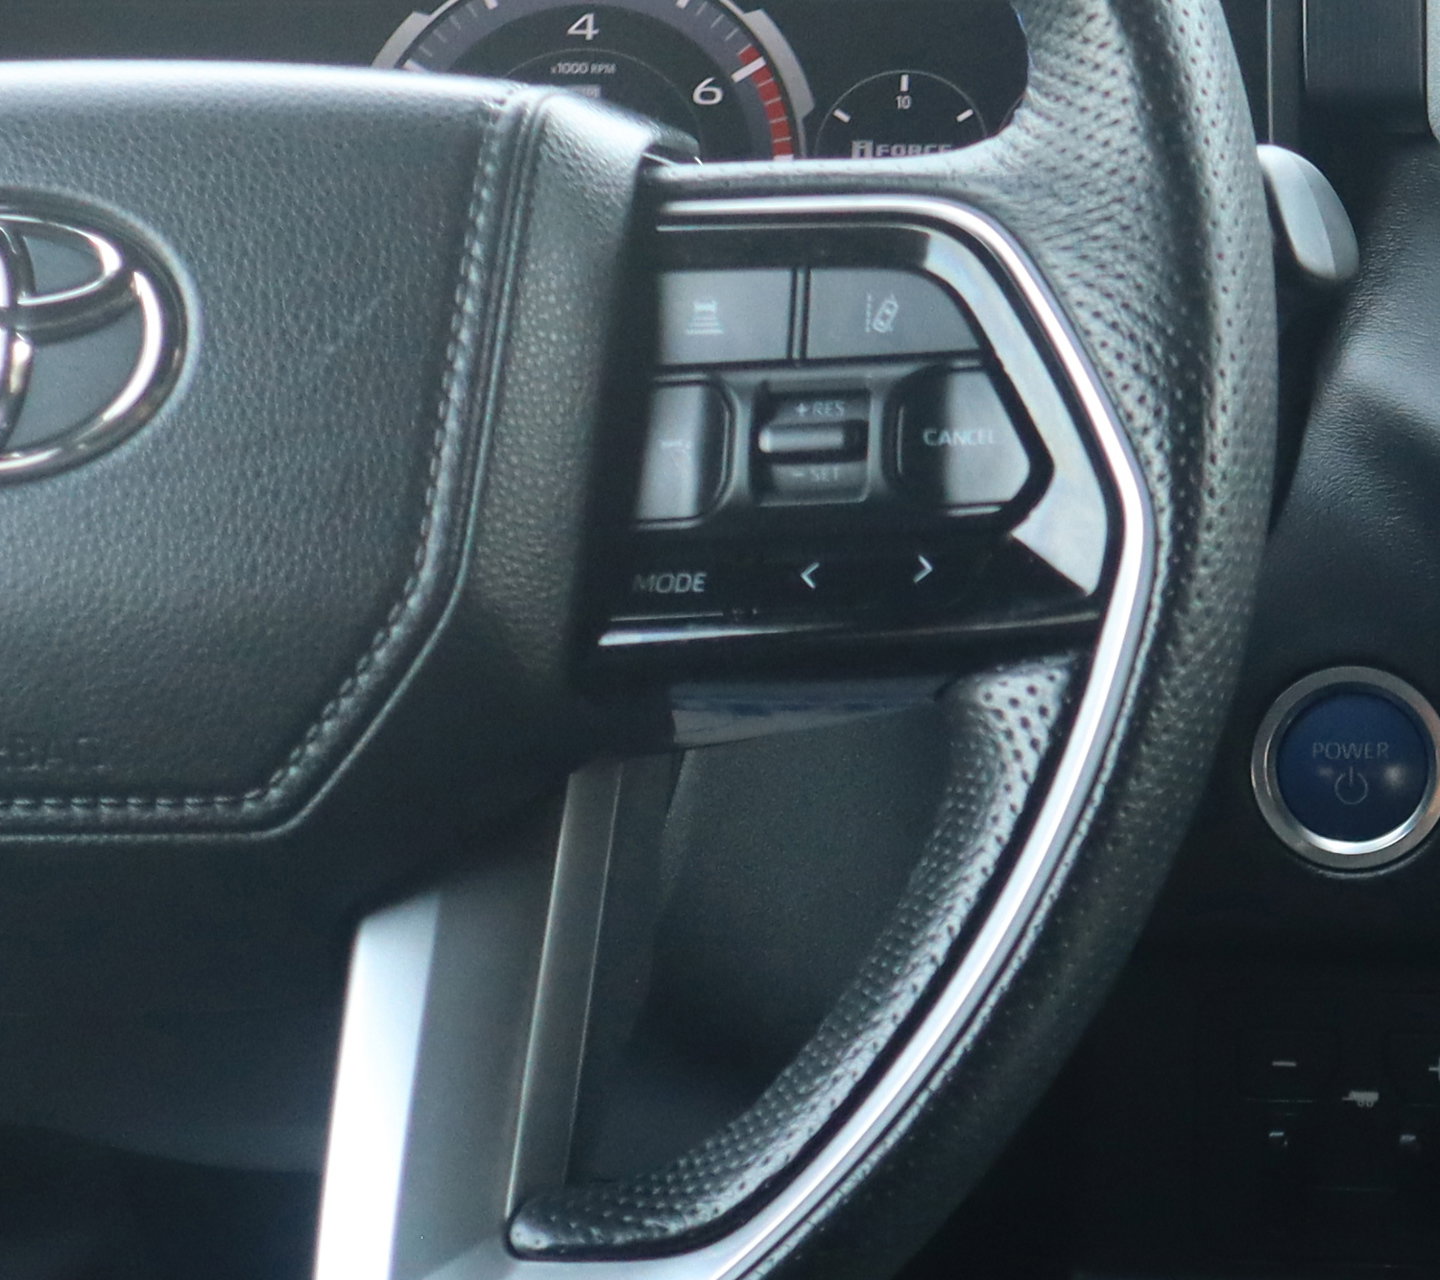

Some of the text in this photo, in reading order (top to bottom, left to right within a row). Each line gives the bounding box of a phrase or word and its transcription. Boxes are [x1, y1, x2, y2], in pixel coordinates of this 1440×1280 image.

[565, 12, 601, 42] 4
[691, 76, 725, 106] 6
[896, 95, 912, 110] 10
[922, 428, 995, 447] CANCEL
[633, 571, 708, 593] MODE
[1311, 740, 1391, 761] POWER
